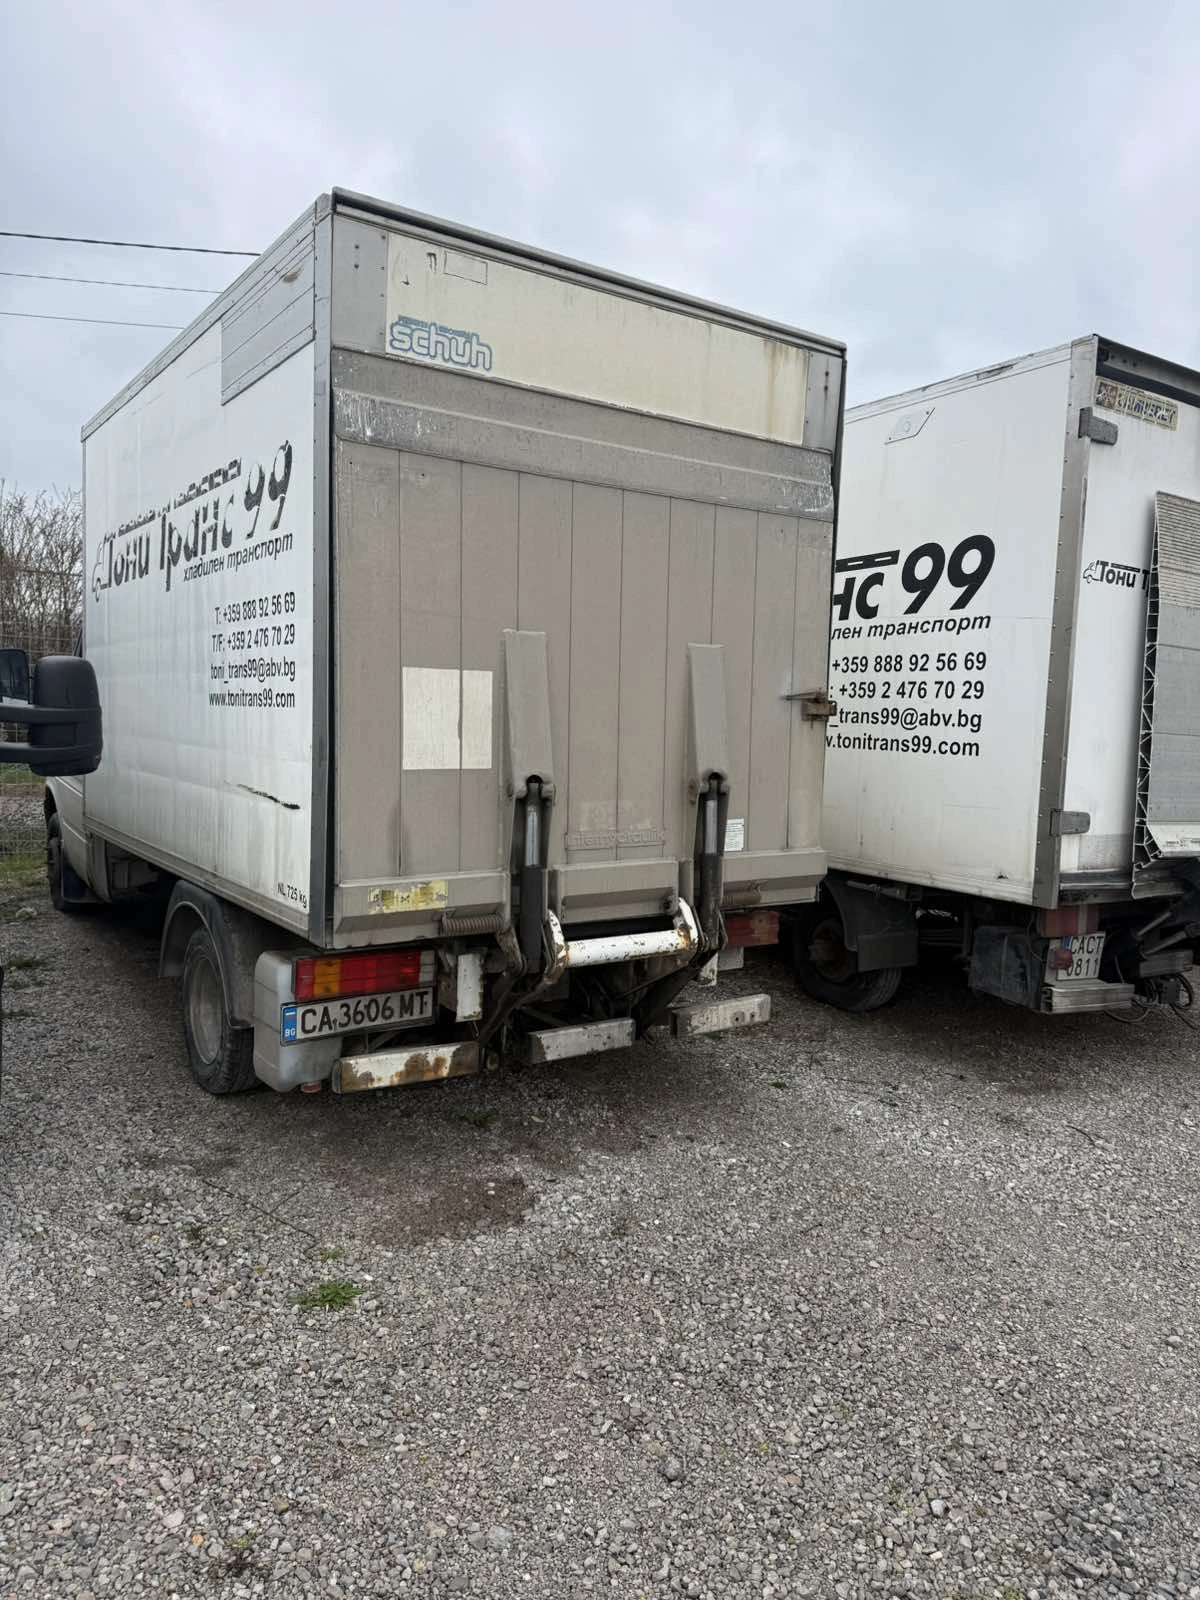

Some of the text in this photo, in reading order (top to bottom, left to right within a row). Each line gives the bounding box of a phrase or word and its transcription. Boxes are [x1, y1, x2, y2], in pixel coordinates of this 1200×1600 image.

[183, 532, 293, 582] хладилен транспорт
[901, 534, 996, 615] 99
[1098, 560, 1137, 588] Тони
[223, 603, 241, 623] +359
[242, 600, 257, 620] 888
[258, 597, 269, 618] 92
[271, 594, 282, 616] 56
[284, 591, 296, 614] 69
[227, 631, 246, 651] +359
[247, 629, 252, 649] 2
[254, 627, 269, 648] 476
[271, 626, 282, 646] 70
[284, 623, 295, 645] 29
[868, 614, 992, 640] транспорт
[210, 656, 296, 684] toni_trans99@abv.bg
[831, 651, 987, 674] +359 888 92 56 69
[208, 688, 296, 708] www.tonitrans99.com
[839, 681, 876, 699] +359
[881, 681, 891, 699] 2
[896, 681, 928, 699] 476
[934, 680, 956, 699] 70
[961, 680, 985, 700] 29
[339, 997, 395, 1028] 3606
[400, 990, 429, 1017] MT
